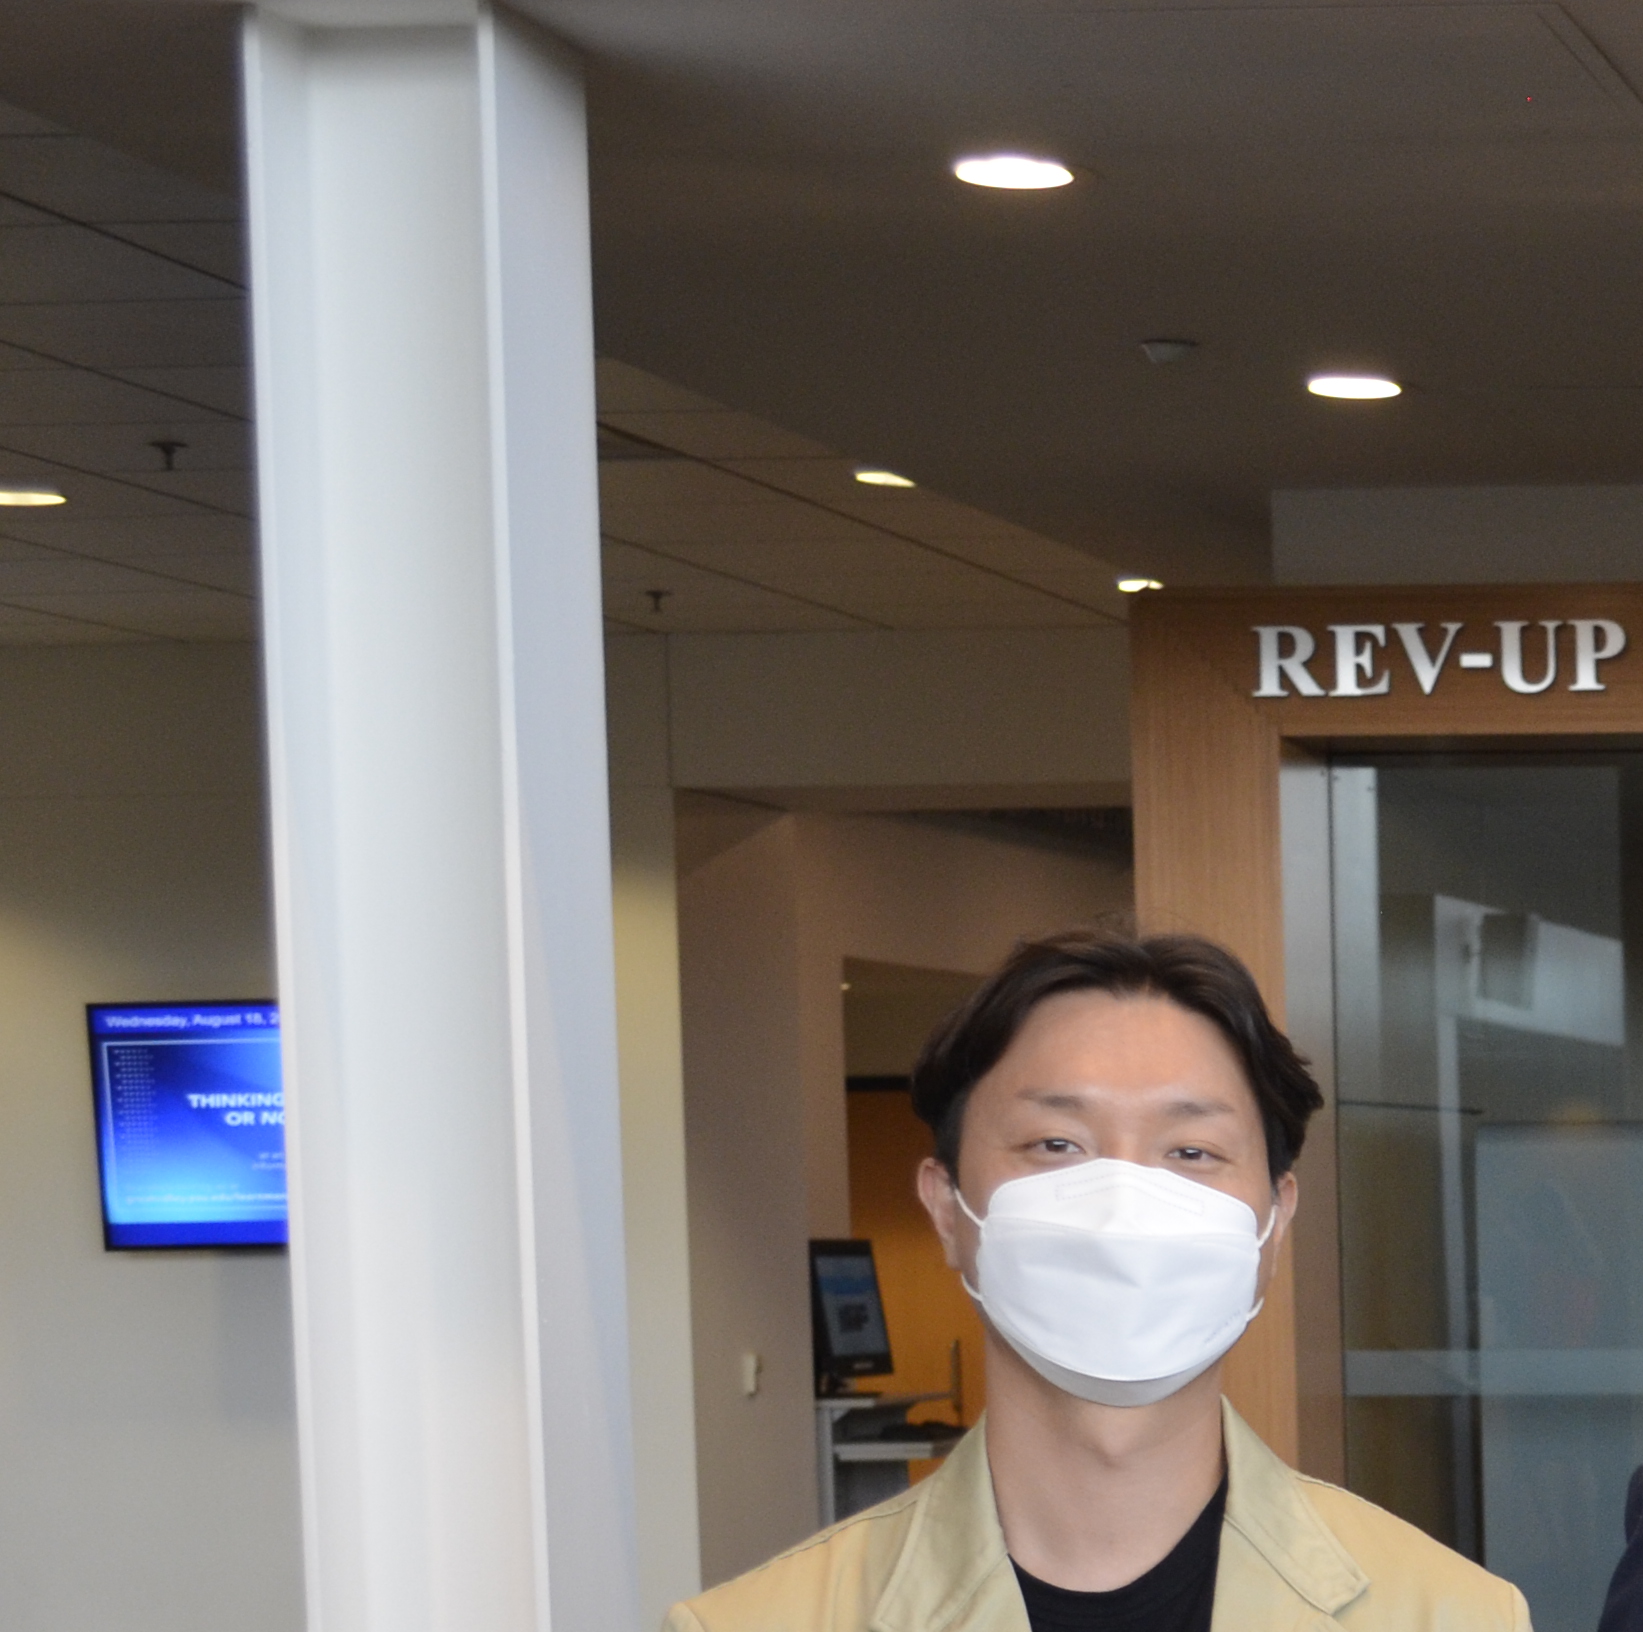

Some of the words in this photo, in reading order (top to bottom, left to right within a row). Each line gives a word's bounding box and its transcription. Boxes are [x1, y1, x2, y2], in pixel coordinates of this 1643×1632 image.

[1251, 620, 1626, 698] REV-UP
[193, 1012, 242, 1028] August
[224, 1111, 255, 1126] OR
